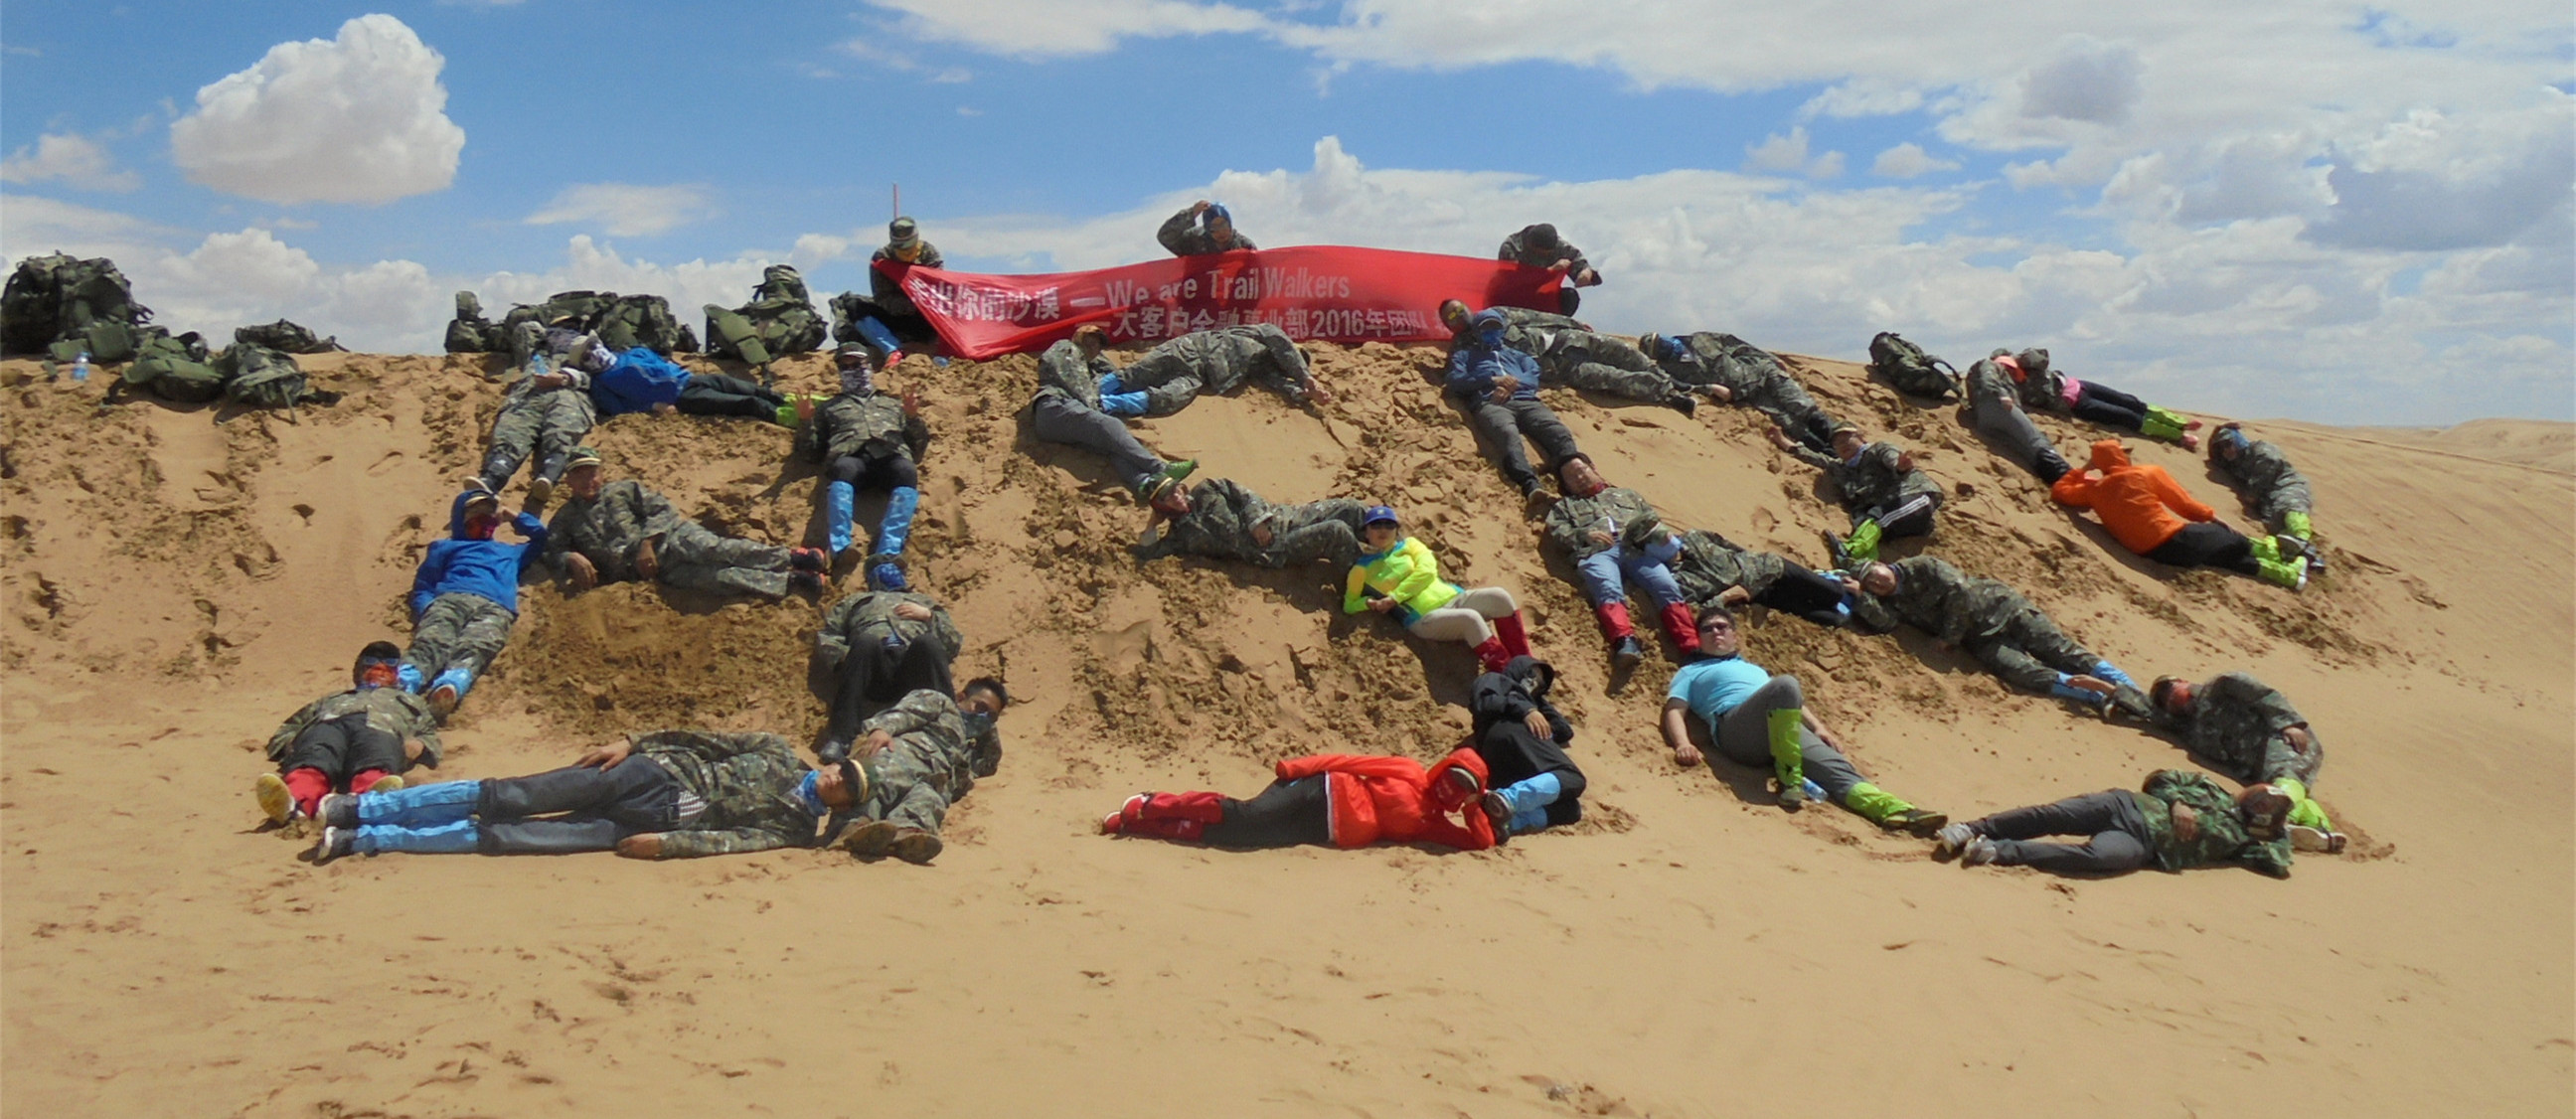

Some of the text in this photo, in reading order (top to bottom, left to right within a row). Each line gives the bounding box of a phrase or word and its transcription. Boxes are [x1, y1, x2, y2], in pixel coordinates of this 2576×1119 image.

[1159, 277, 1199, 301] are
[1207, 267, 1260, 300] Trail
[1264, 266, 1351, 298] Walkers
